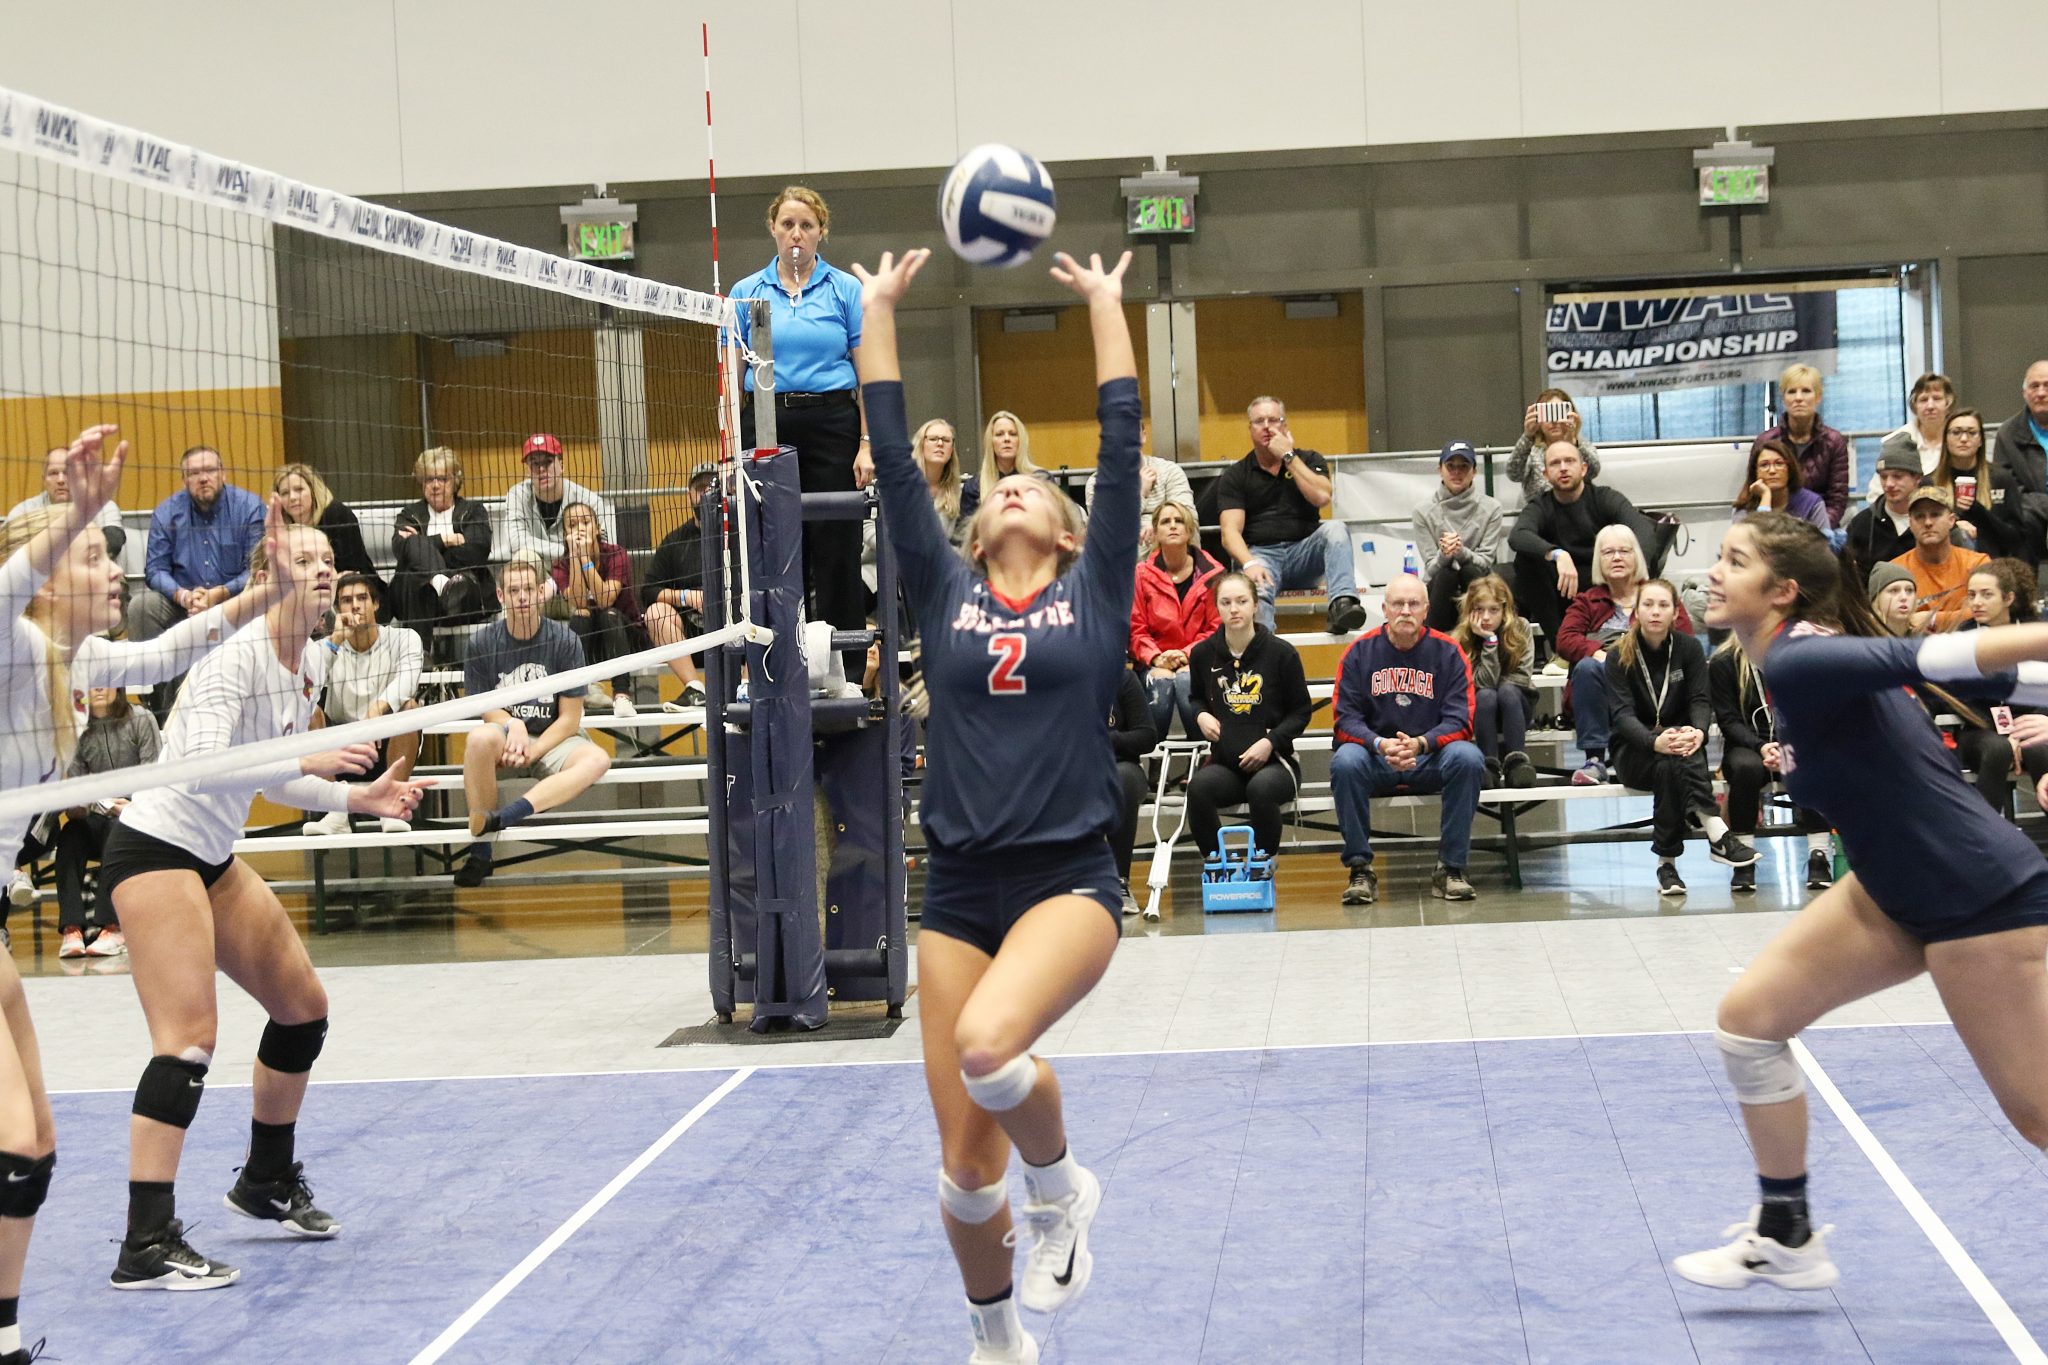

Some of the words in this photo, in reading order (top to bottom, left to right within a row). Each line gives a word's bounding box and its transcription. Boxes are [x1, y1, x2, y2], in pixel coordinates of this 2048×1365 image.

[1139, 197, 1185, 230] EXIT
[580, 223, 625, 257] EXIT
[1547, 329, 1799, 371] CHAMPIONSHIP
[987, 632, 1027, 696] 2
[1371, 667, 1435, 700] GONZAGA
